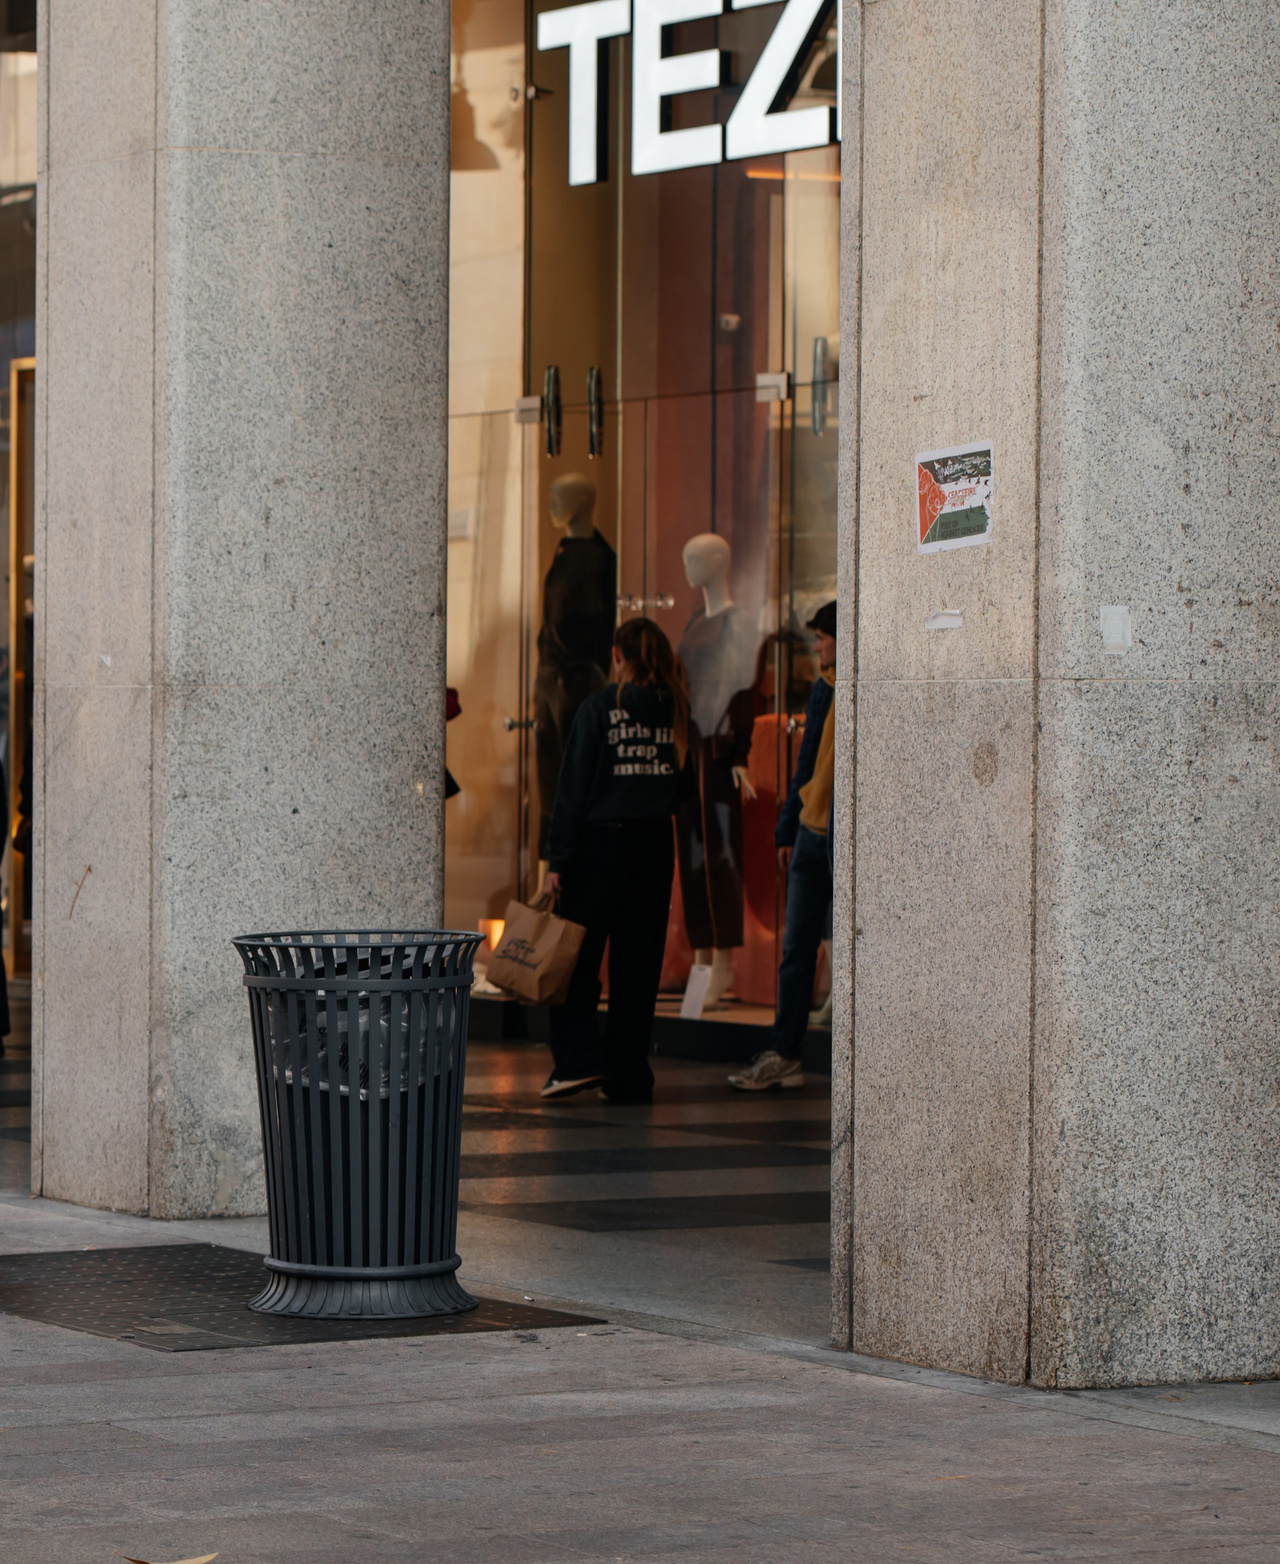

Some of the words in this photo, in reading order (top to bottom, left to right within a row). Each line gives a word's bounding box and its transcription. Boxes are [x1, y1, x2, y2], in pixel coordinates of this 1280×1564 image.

[537, 0, 842, 187] TEZ
[952, 520, 959, 528] UP
[608, 722, 651, 745] girls
[617, 743, 658, 760] trap
